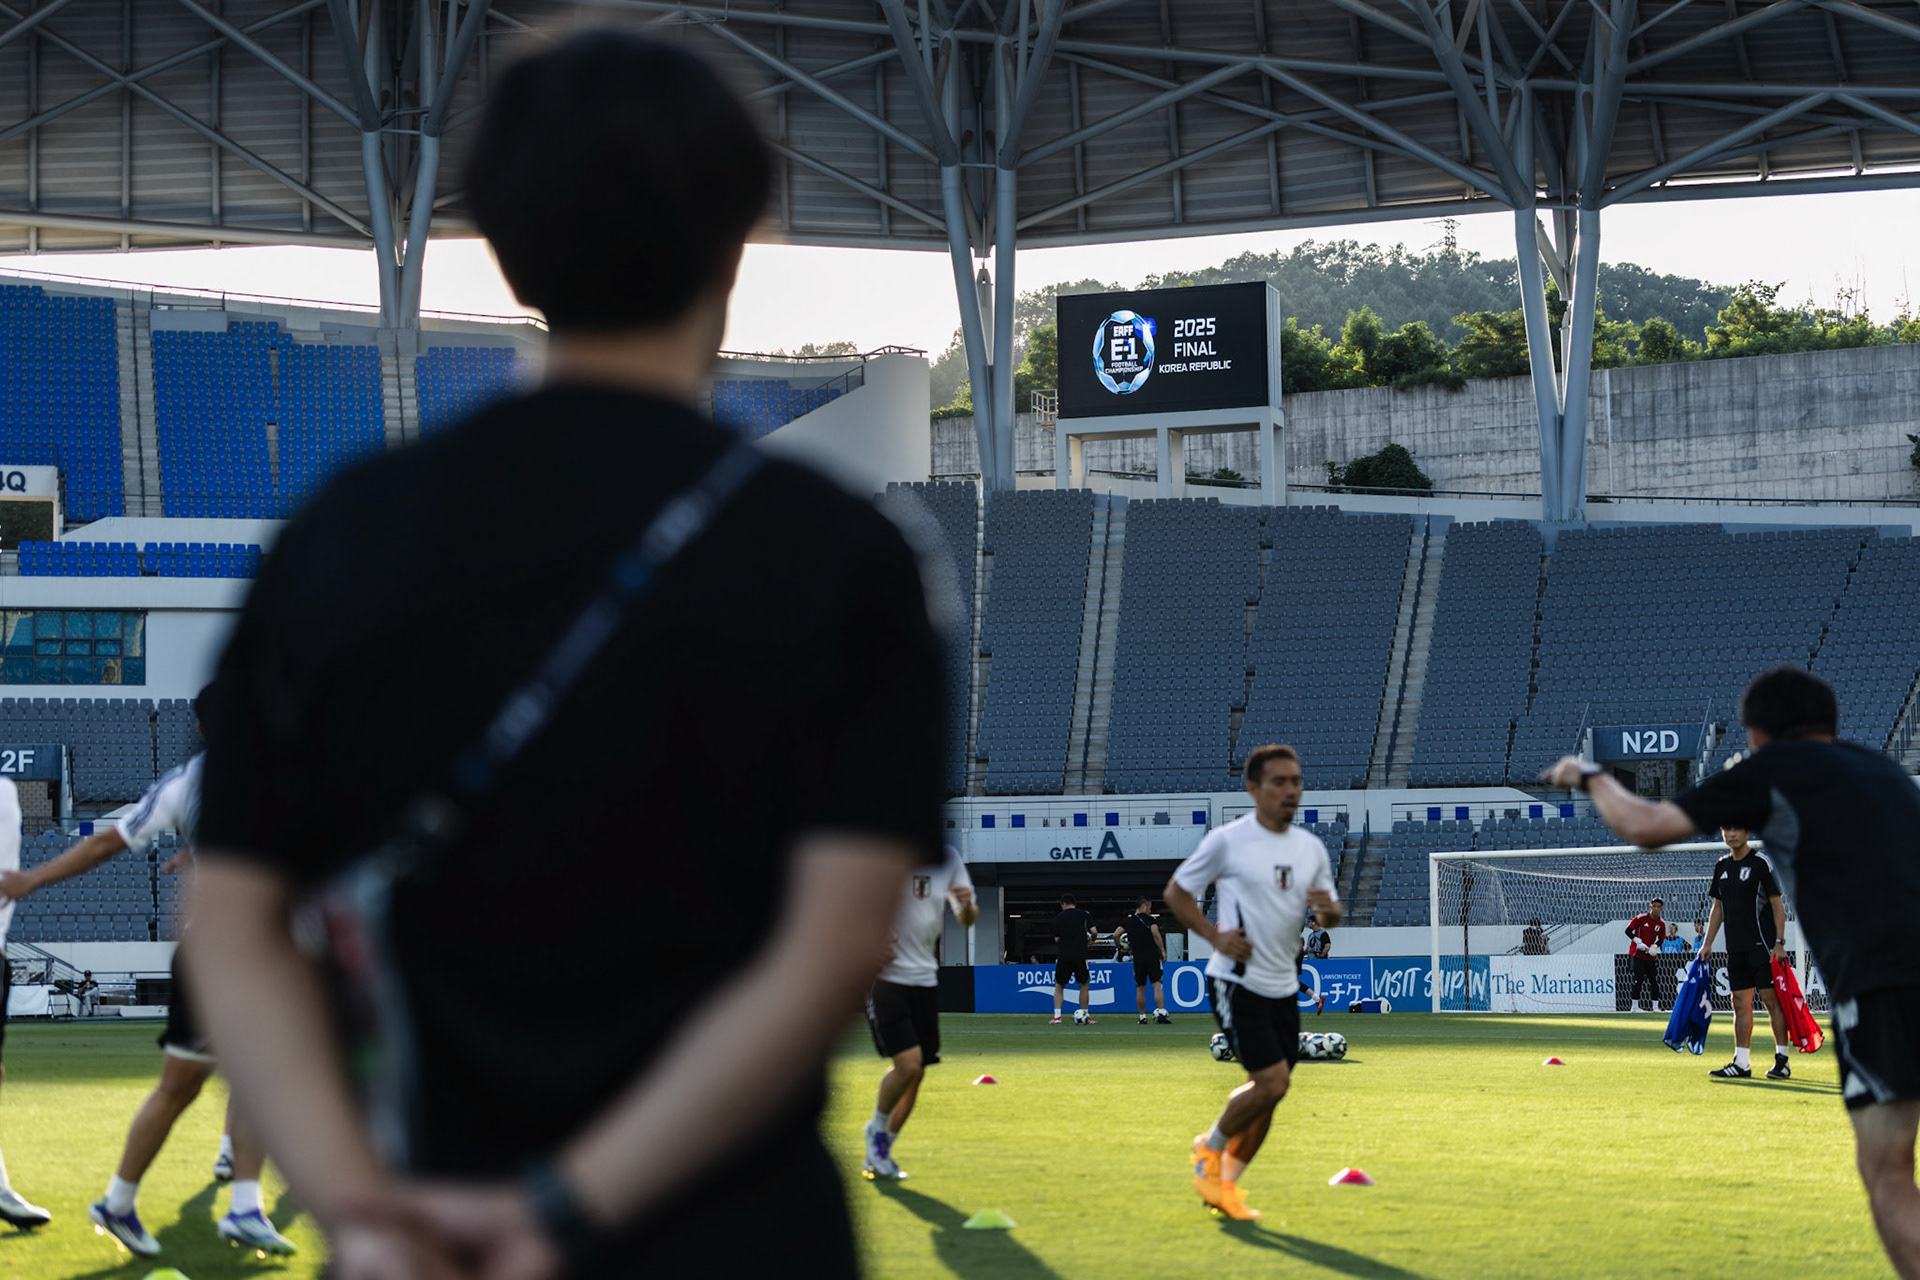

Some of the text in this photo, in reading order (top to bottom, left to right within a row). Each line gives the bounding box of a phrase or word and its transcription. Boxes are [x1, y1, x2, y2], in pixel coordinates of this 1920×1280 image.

[1113, 324, 1134, 337] EAFF
[1174, 317, 1216, 338] 2025
[1111, 337, 1138, 361] E-1
[1174, 340, 1217, 358] FINAL
[1104, 366, 1144, 374] CHAMPIONSHIP
[1158, 360, 1232, 373] KOREA REPUBLIC
[1622, 730, 1679, 754] N2D
[1050, 831, 1125, 860] GATE A
[1374, 967, 1422, 998] VISIT
[1492, 973, 1615, 995] The Marianas
